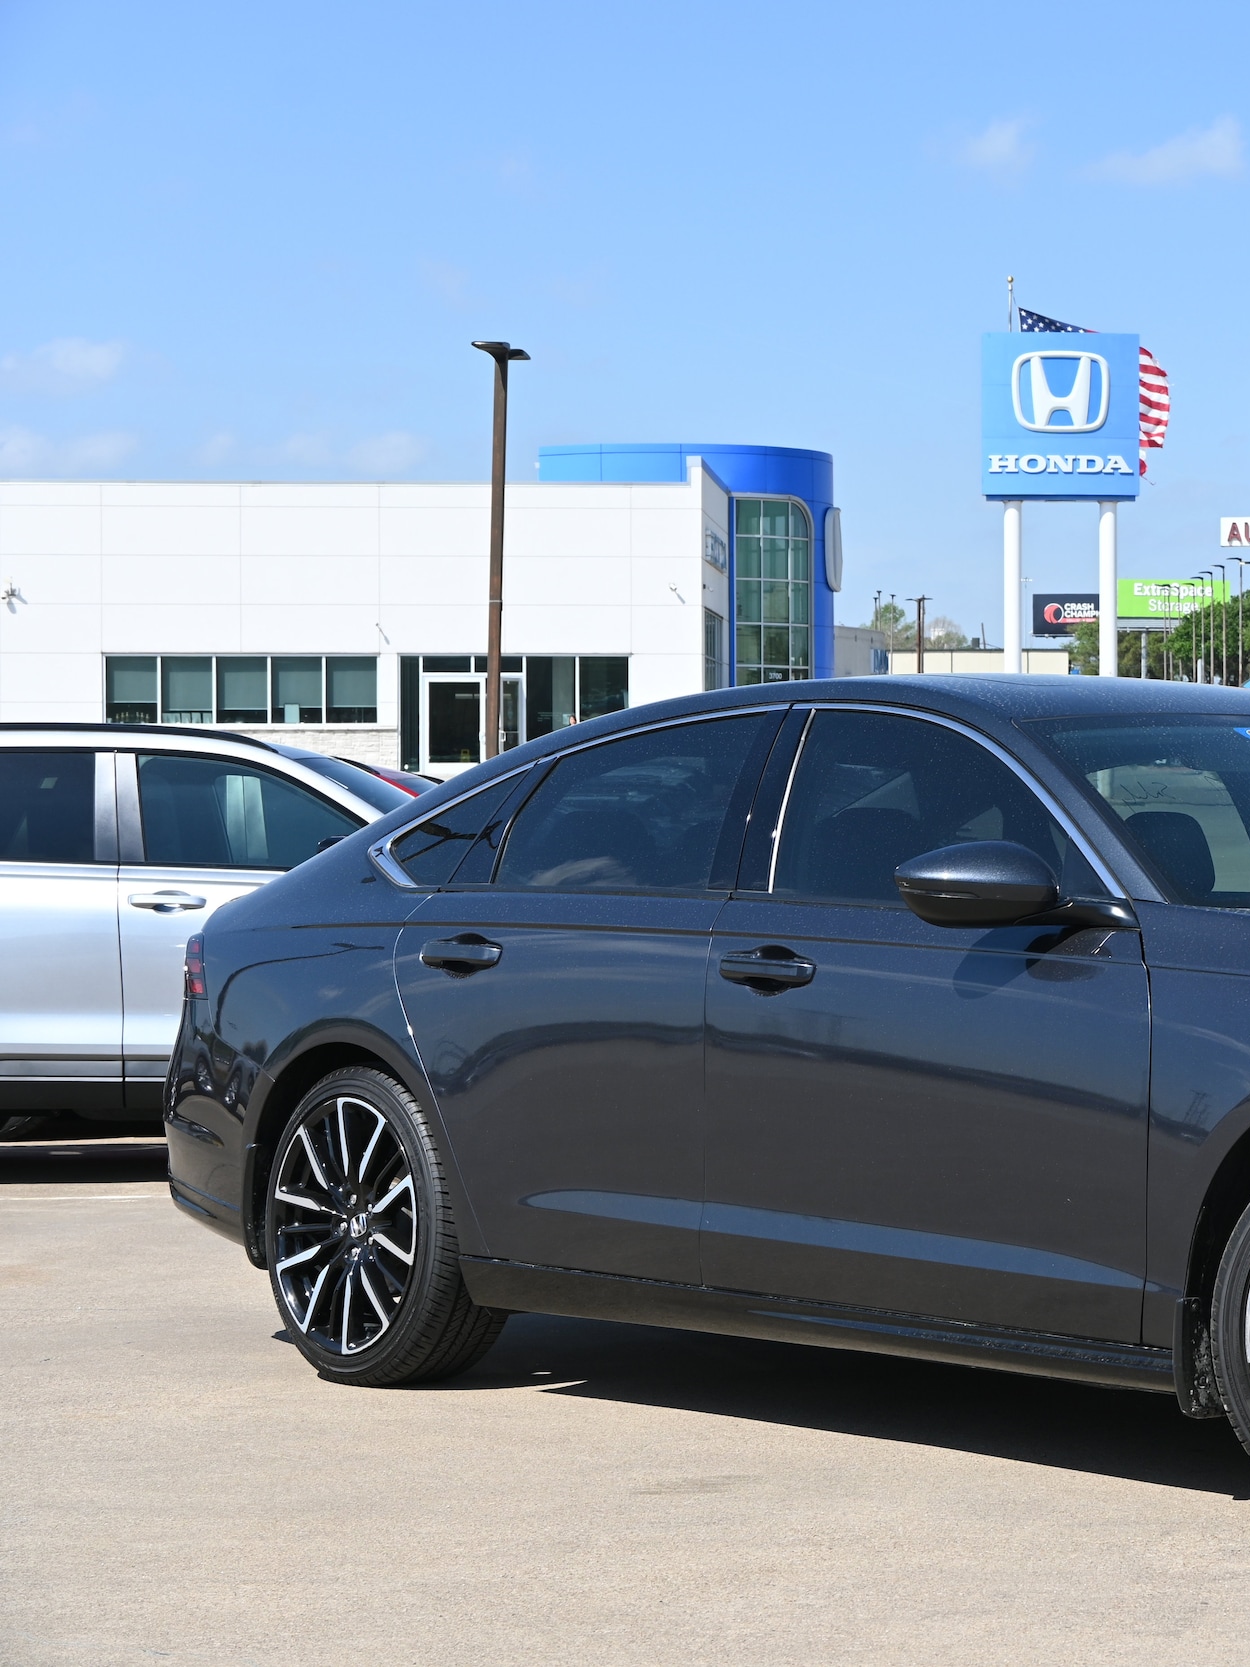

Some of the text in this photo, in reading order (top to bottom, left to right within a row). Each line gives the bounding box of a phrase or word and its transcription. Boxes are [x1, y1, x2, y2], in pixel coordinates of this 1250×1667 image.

[988, 454, 1134, 474] HONDA
[1064, 603, 1095, 611] CRASH
[1148, 599, 1199, 614] Storage
[769, 672, 783, 680] 3700
